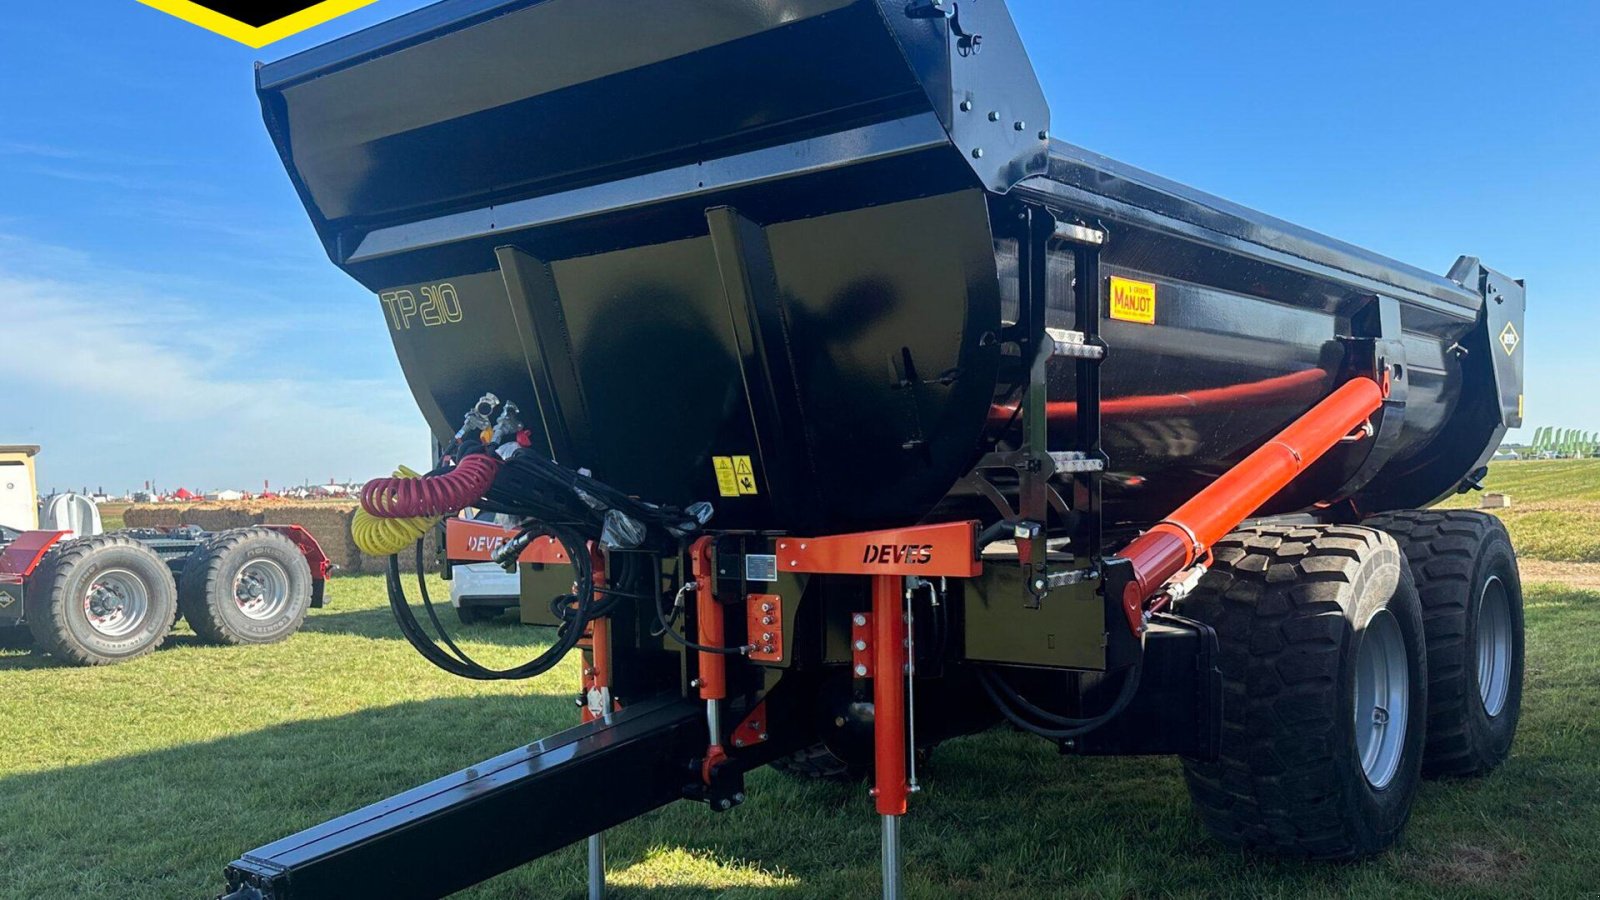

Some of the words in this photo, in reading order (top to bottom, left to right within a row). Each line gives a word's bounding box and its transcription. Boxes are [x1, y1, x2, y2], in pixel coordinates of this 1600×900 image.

[381, 290, 417, 330] TP
[420, 283, 463, 326] 210
[1114, 285, 1151, 313] MANJOT
[863, 544, 933, 564] DEVES
